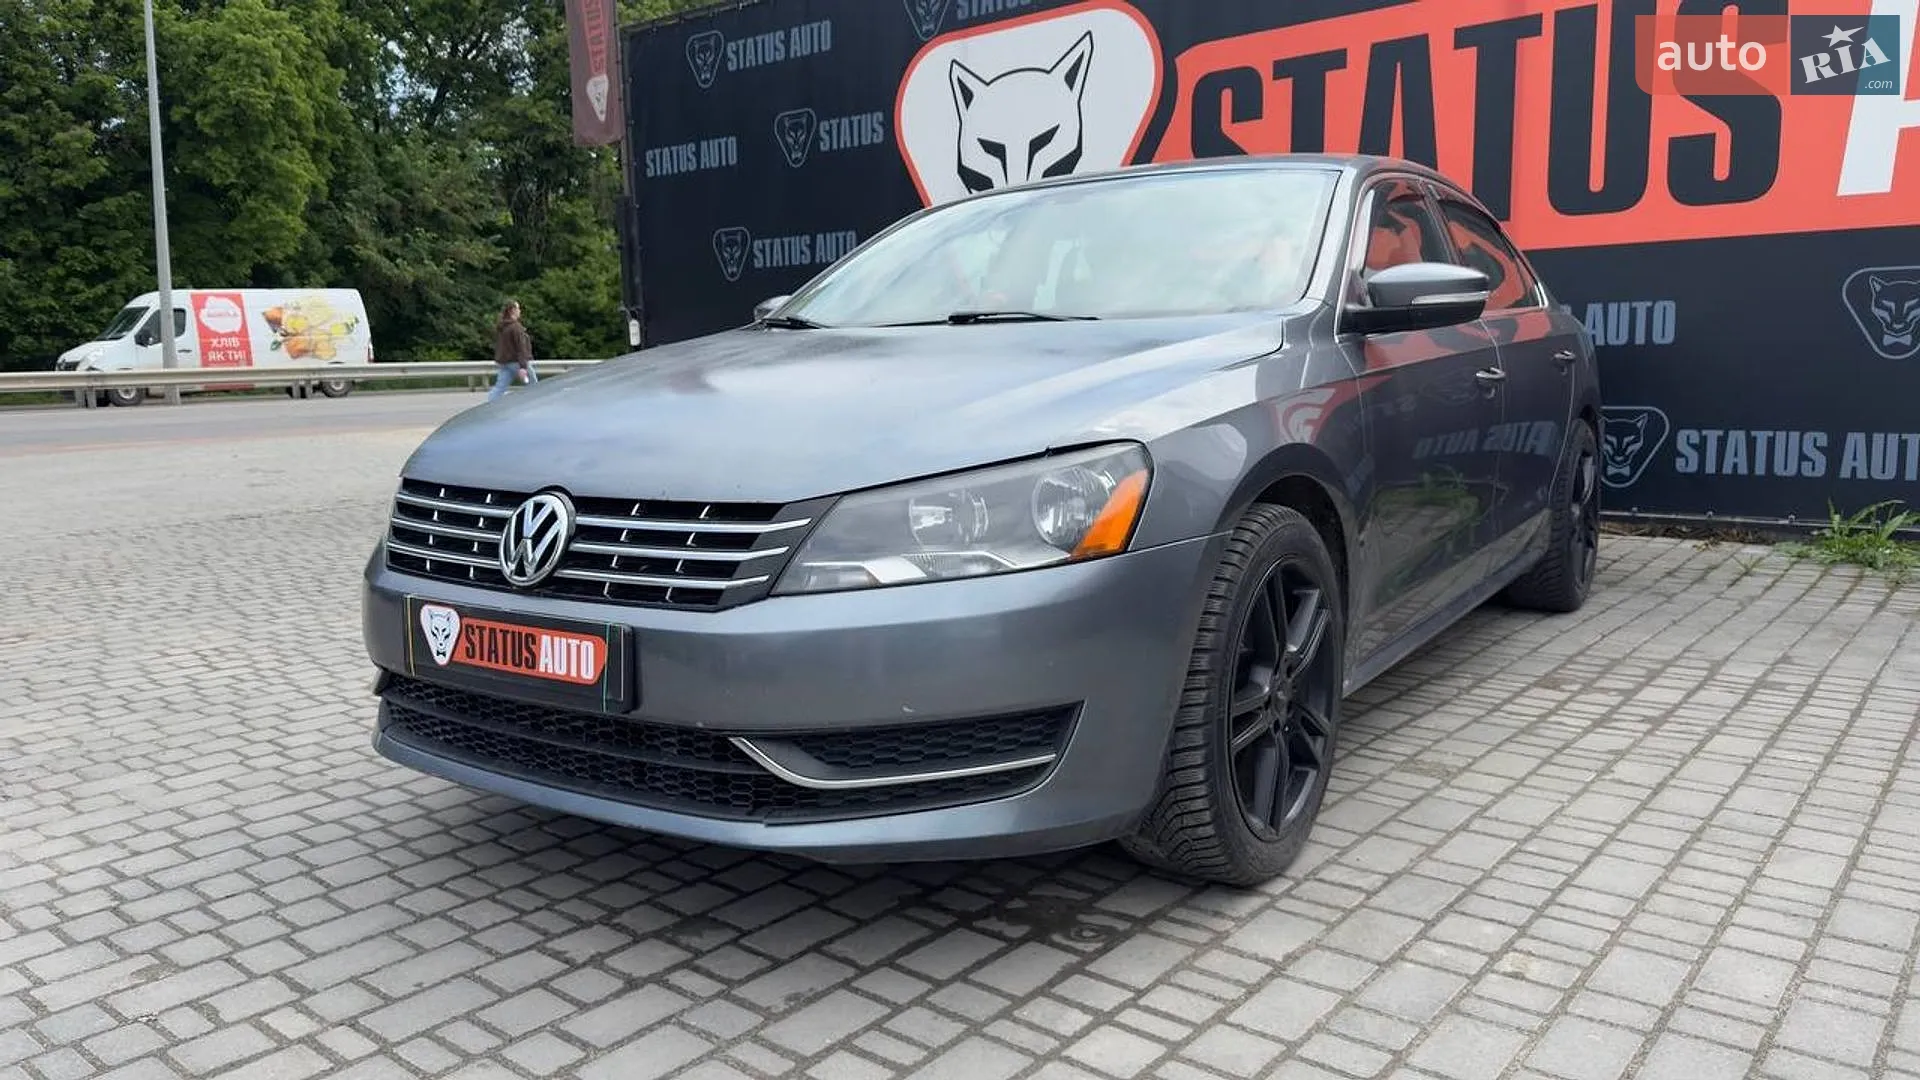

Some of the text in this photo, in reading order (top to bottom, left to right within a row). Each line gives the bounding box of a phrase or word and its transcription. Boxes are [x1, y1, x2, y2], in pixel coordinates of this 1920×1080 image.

[727, 19, 832, 72] STATUS AUTO
[819, 112, 885, 151] STATUS
[645, 136, 738, 178] STATUS AUTO
[753, 230, 857, 268] STATUS AUTO
[1585, 300, 1676, 346] AUTO
[1675, 429, 1920, 481] STATUS AUT
[464, 624, 595, 680] STATUS AUTO
